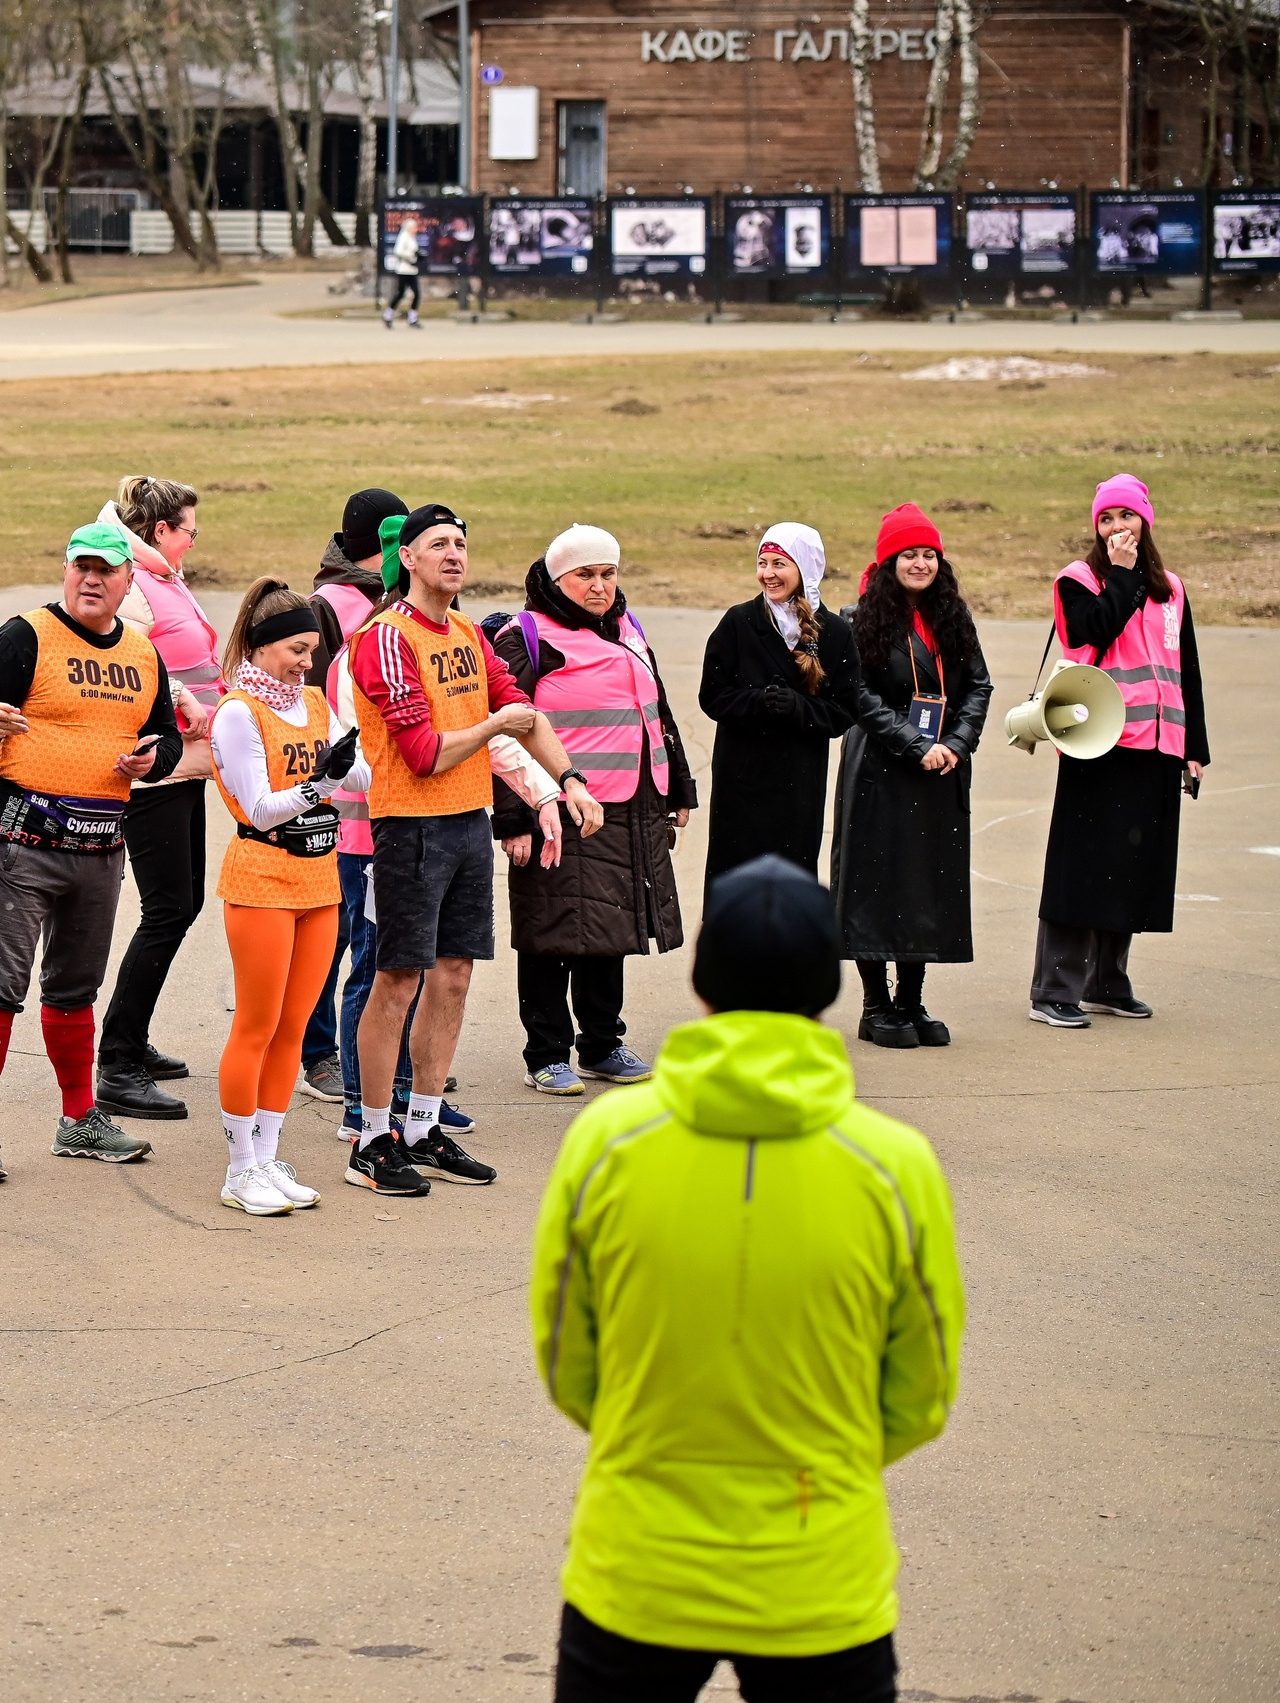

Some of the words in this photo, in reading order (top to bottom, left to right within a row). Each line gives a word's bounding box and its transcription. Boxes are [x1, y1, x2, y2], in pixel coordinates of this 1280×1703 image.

[640, 29, 751, 62] КАФЕ
[773, 29, 937, 62] ГАЛРЕ
[67, 657, 142, 692] 30:00
[80, 688, 99, 698] 6:00
[30, 794, 50, 808] 9:00
